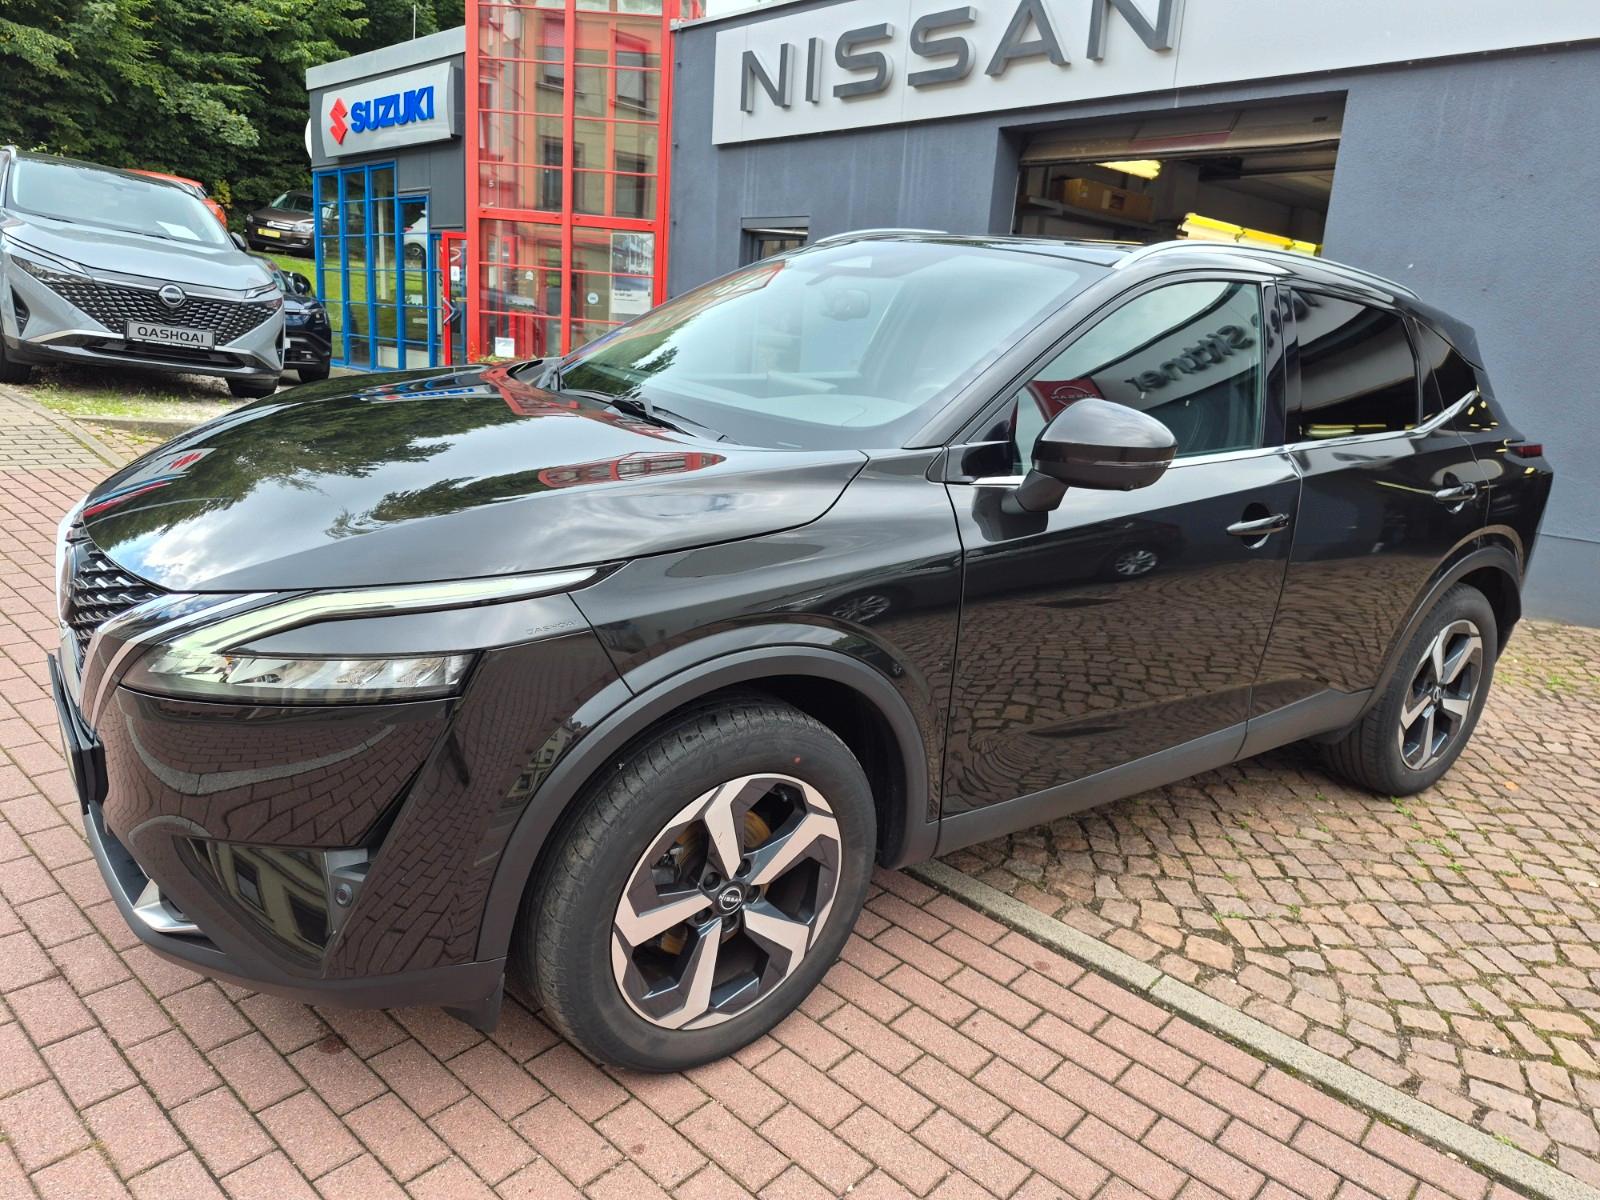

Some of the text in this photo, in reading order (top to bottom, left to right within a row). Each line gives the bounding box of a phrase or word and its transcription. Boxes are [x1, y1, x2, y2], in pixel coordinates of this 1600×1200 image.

[740, 0, 1175, 113] NISSAN
[350, 86, 434, 133] SUZUKI
[137, 326, 204, 344] QASHQAI
